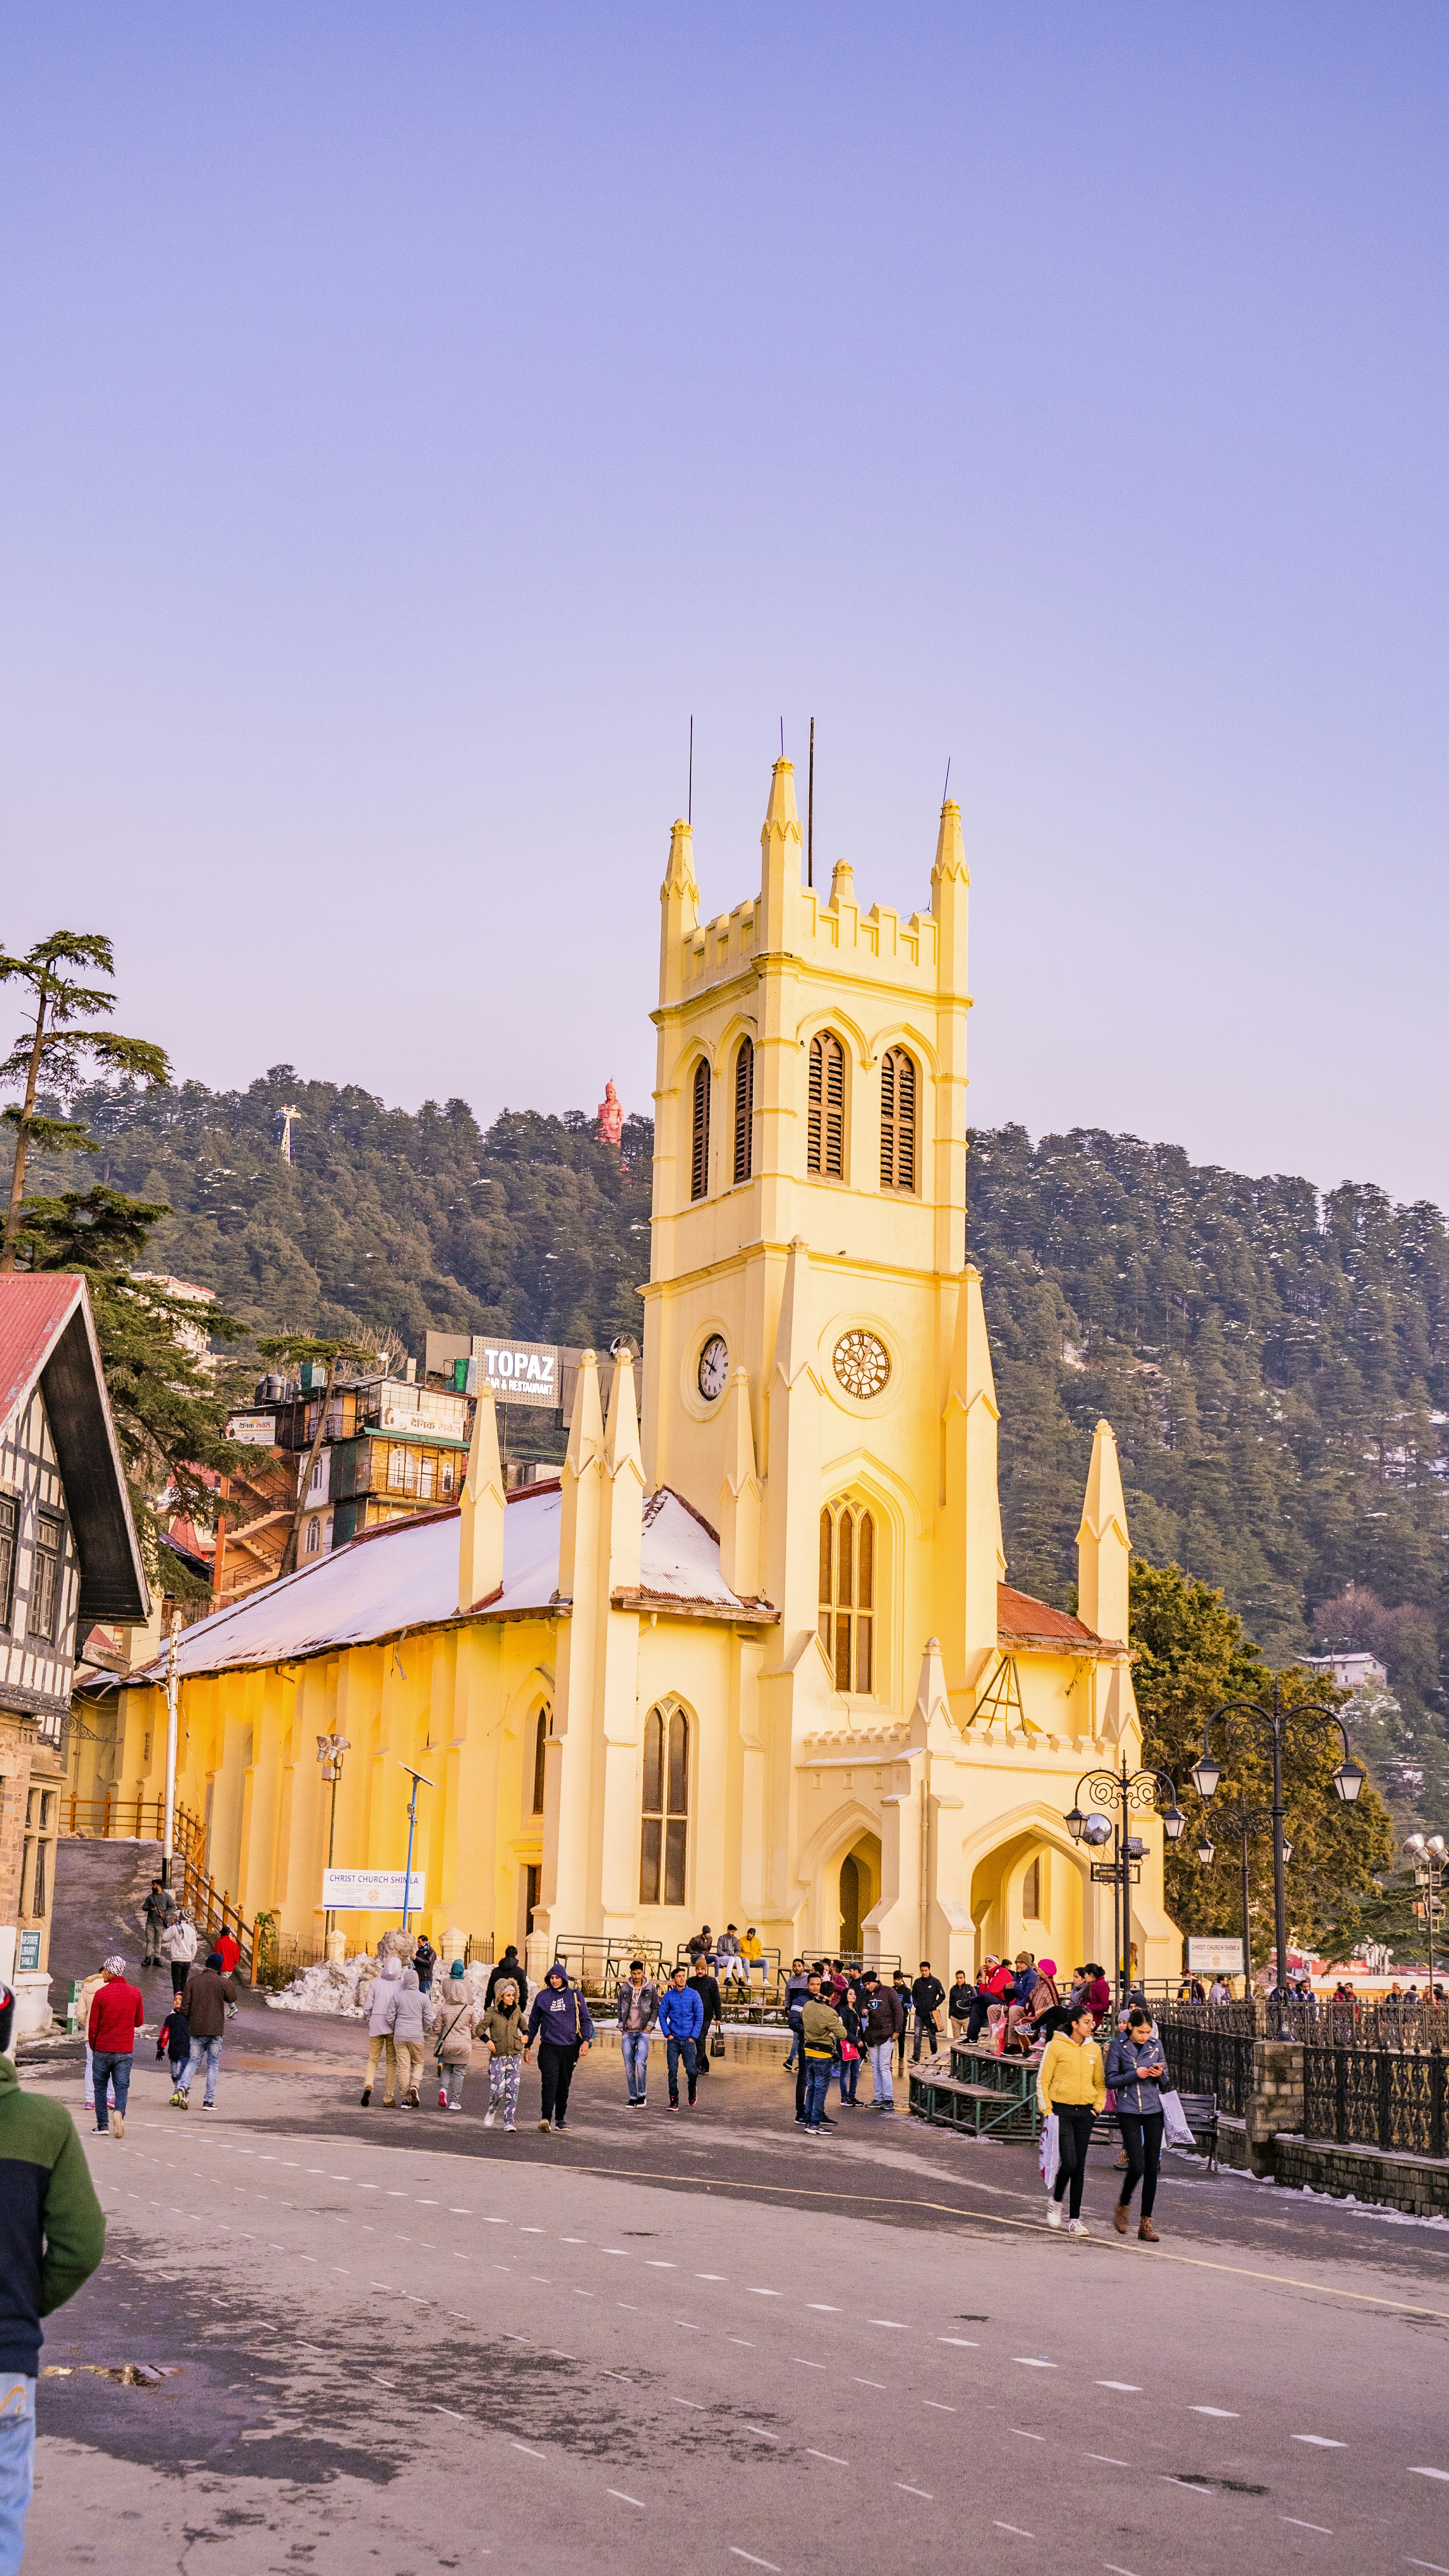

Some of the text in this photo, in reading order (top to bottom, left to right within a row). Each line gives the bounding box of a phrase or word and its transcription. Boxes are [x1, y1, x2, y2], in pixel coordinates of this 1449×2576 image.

[484, 1349, 554, 1382] TOPAZ
[500, 1379, 507, 1389] &
[508, 1379, 553, 1395] RESTAURANT
[410, 1417, 461, 1434] दैनिक सवेरा
[21, 1946, 36, 1955] LIBRARY
